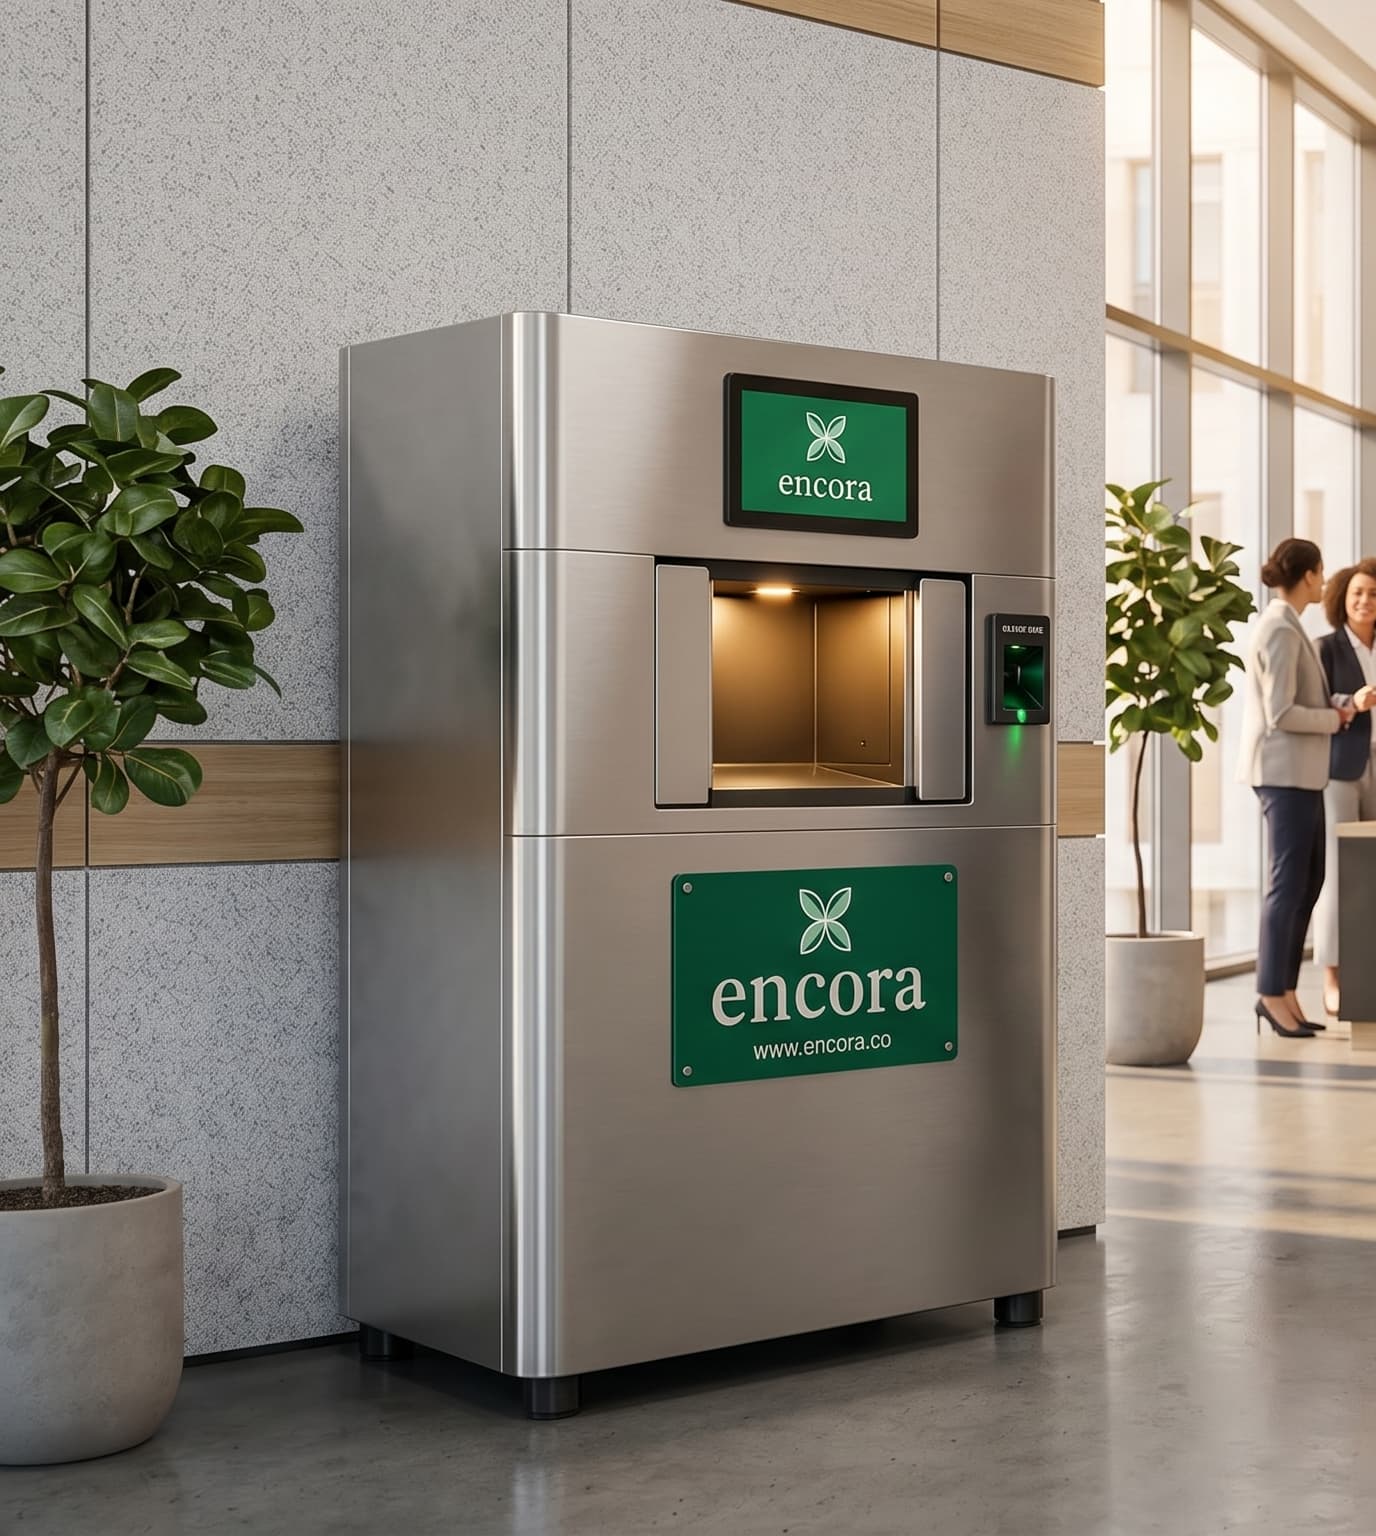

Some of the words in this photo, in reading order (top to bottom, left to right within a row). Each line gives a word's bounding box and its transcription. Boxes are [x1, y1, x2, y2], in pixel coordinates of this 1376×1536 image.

[778, 474, 873, 502] encora
[711, 965, 927, 1027] encora
[753, 1033, 892, 1060] www.encora.co
